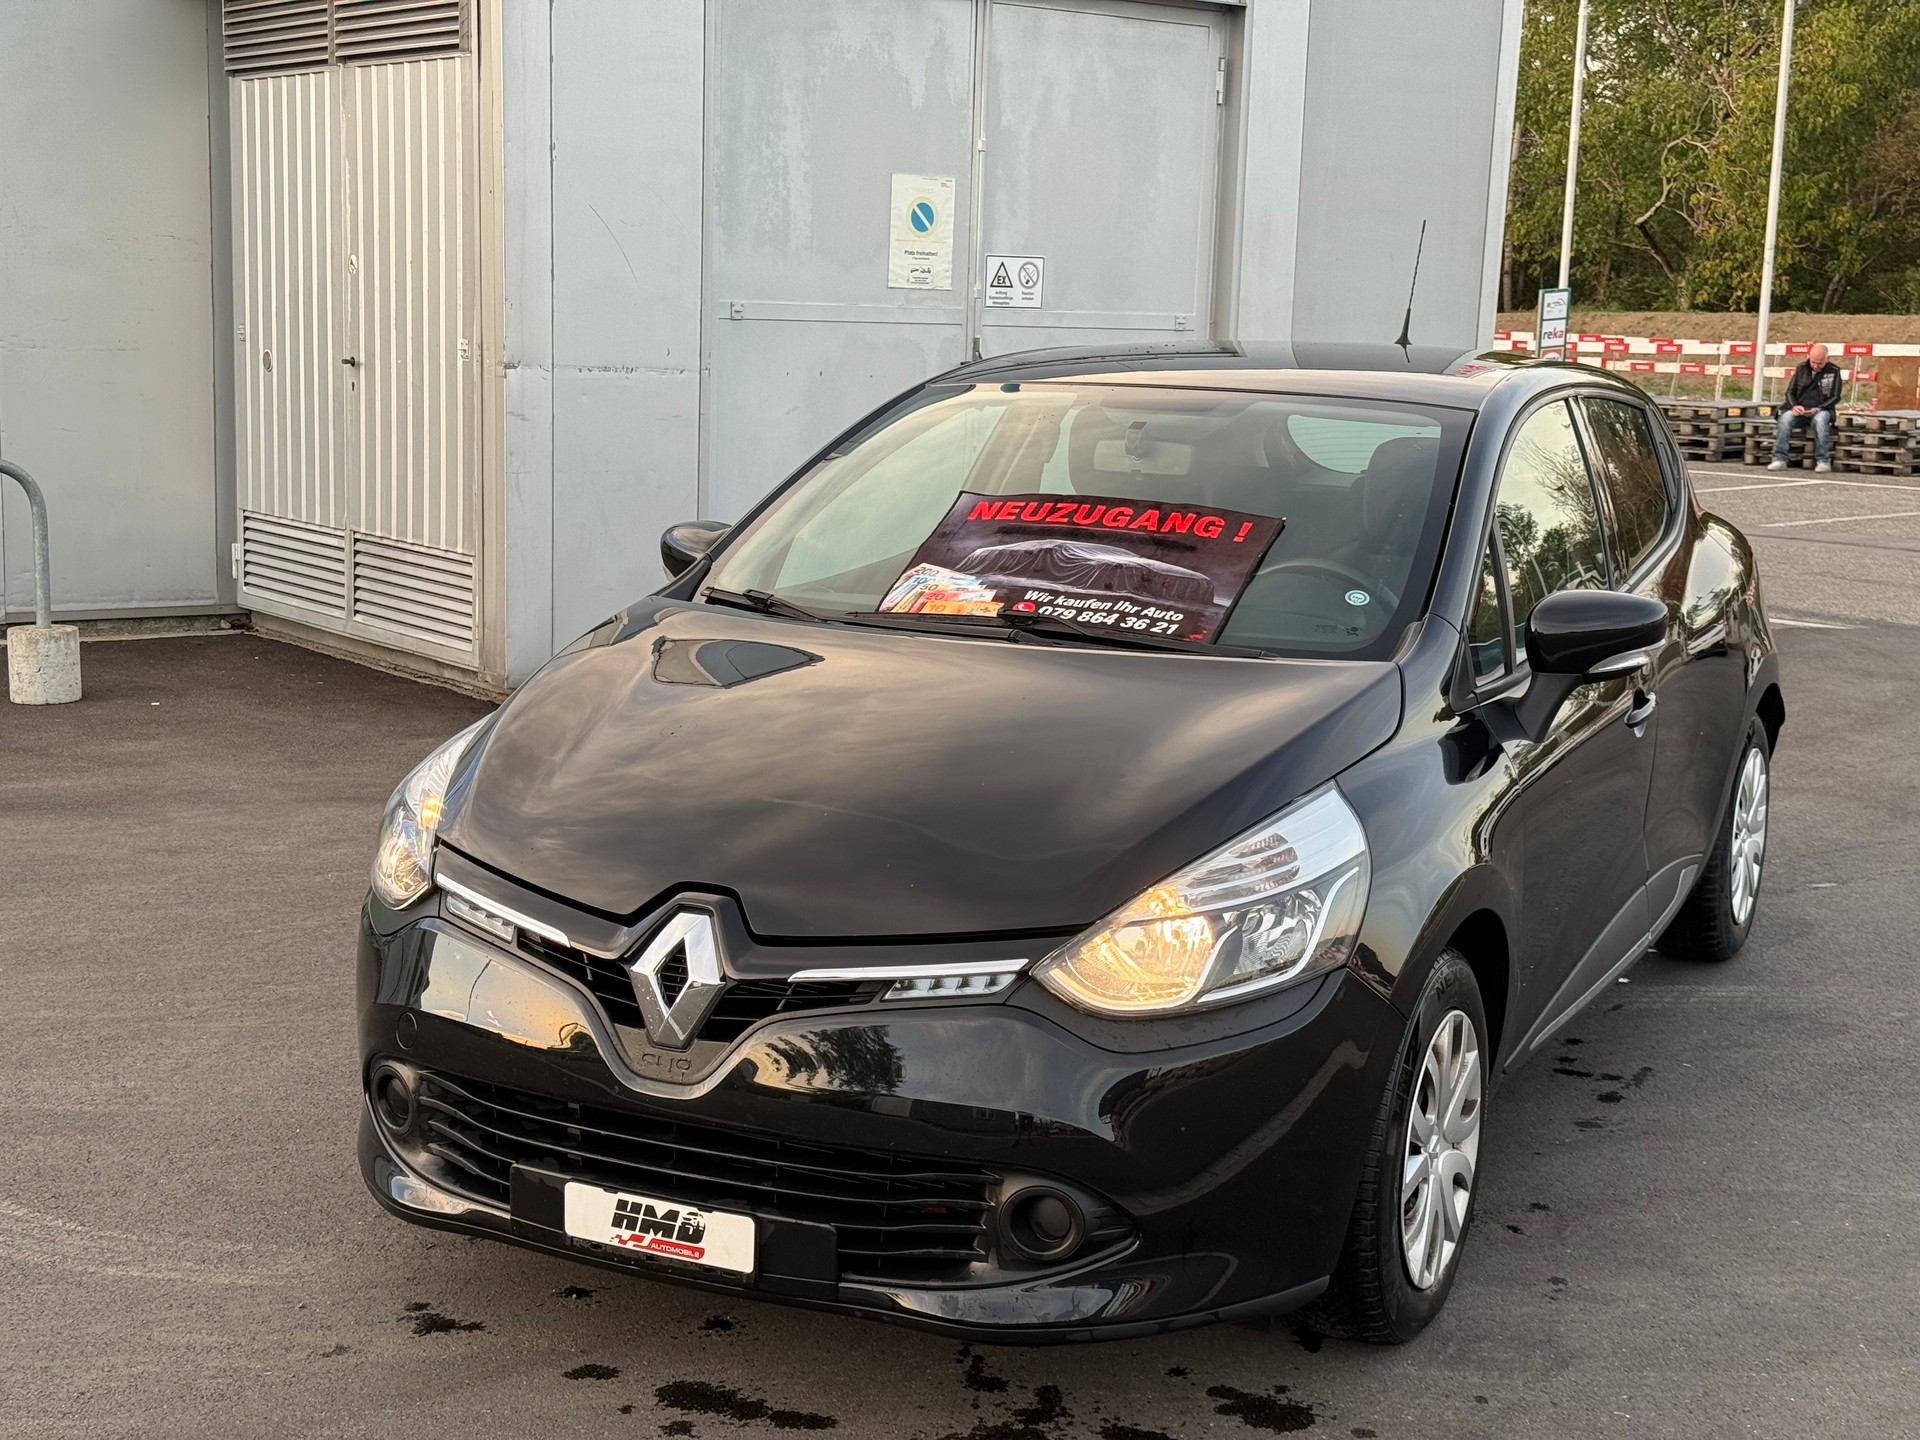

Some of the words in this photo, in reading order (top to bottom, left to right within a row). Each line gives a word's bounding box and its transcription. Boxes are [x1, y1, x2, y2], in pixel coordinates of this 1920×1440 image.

[997, 275, 1007, 285] EX
[1543, 327, 1564, 340] reka
[967, 500, 1226, 539] NEUZUGANG
[920, 583, 939, 591] 50
[924, 590, 945, 601] 20
[929, 604, 946, 613] 10
[1023, 590, 1052, 603] Wir
[1053, 595, 1110, 610] kaufen
[1114, 600, 1141, 615] Ihr
[1141, 606, 1185, 622] Auto
[1076, 609, 1120, 625] 864
[1120, 616, 1151, 630] 36
[1149, 621, 1180, 635] 21
[650, 1242, 701, 1258] AUTOMOBILE
